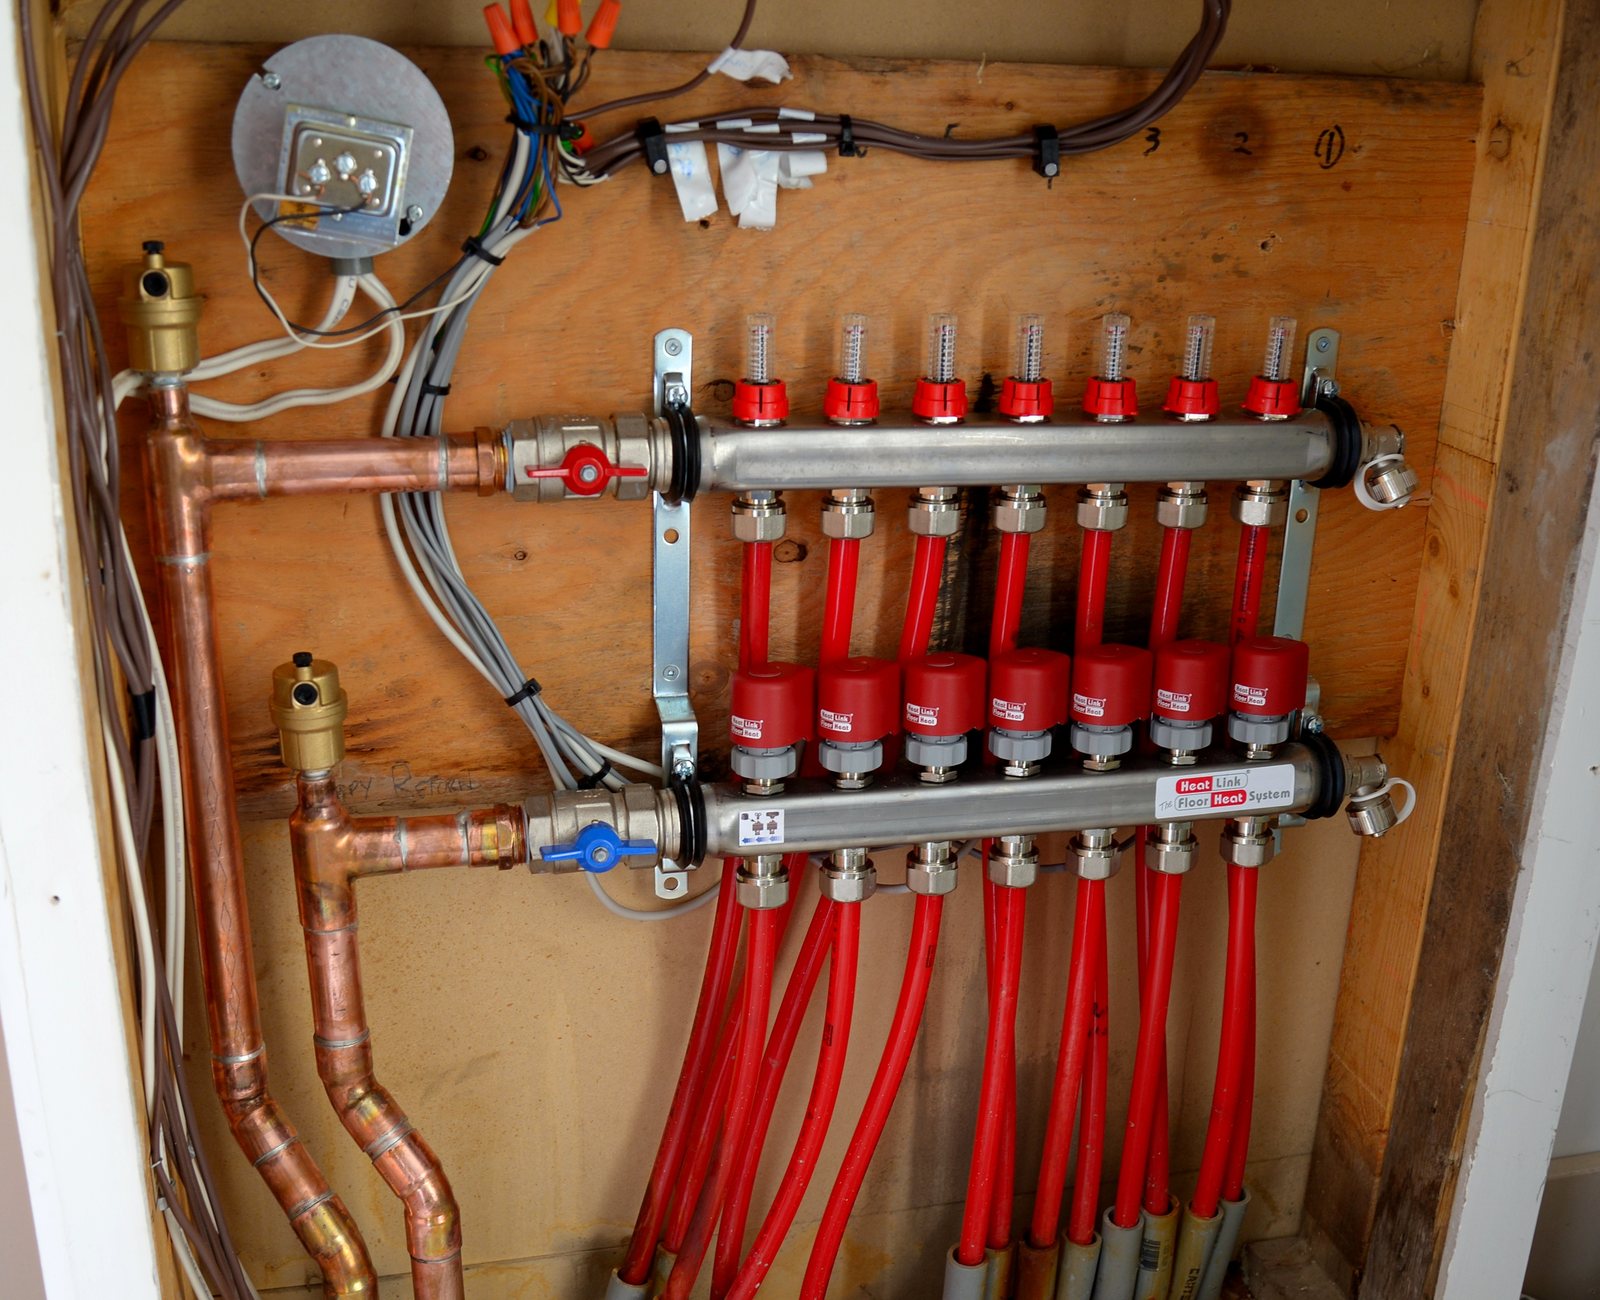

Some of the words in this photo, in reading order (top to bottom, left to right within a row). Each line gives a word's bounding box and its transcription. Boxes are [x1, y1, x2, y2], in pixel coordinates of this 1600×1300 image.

[1142, 127, 1161, 157] 3
[1234, 131, 1253, 156] 2
[1180, 779, 1211, 792] Heat
[1216, 776, 1241, 788] Link
[1159, 800, 1173, 811] The
[1178, 797, 1209, 809] Floor
[1213, 792, 1244, 805] Heat
[1248, 788, 1291, 804] System
